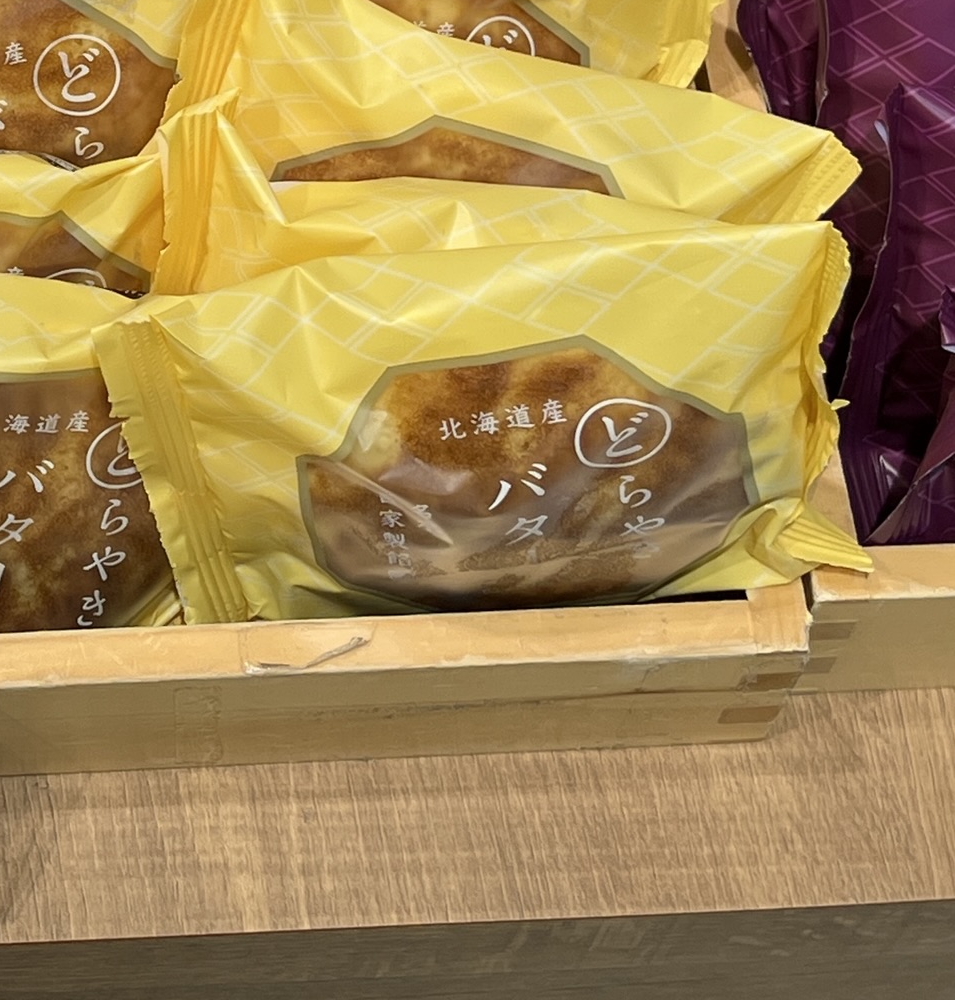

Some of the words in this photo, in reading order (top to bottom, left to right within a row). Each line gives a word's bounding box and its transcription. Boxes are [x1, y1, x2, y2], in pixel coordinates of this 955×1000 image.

[57, 47, 105, 160] どら
[439, 398, 569, 442] 北海道産
[379, 493, 412, 569] 家製餡
